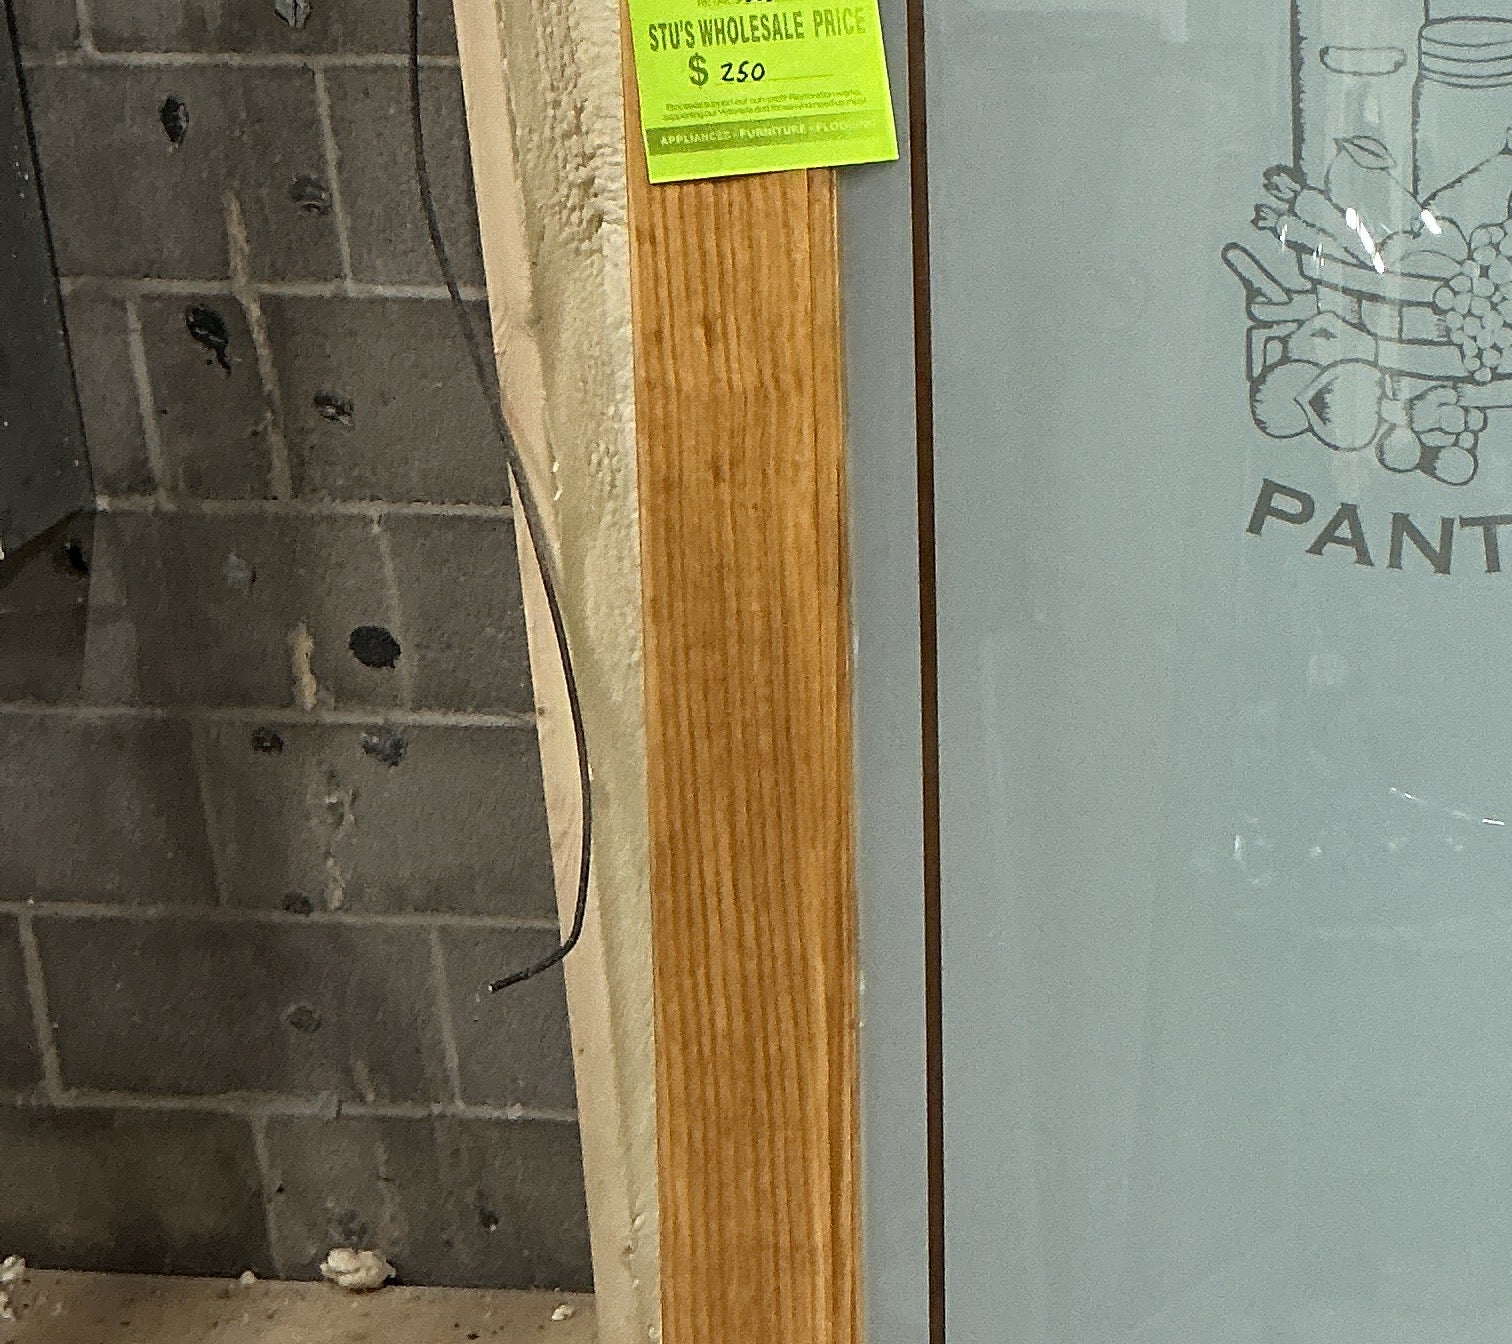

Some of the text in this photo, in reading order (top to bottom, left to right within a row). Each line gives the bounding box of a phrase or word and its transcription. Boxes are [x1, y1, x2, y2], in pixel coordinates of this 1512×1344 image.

[649, 7, 867, 51] STU'S WHOLESALE PRICE
[688, 52, 766, 89] $ 250
